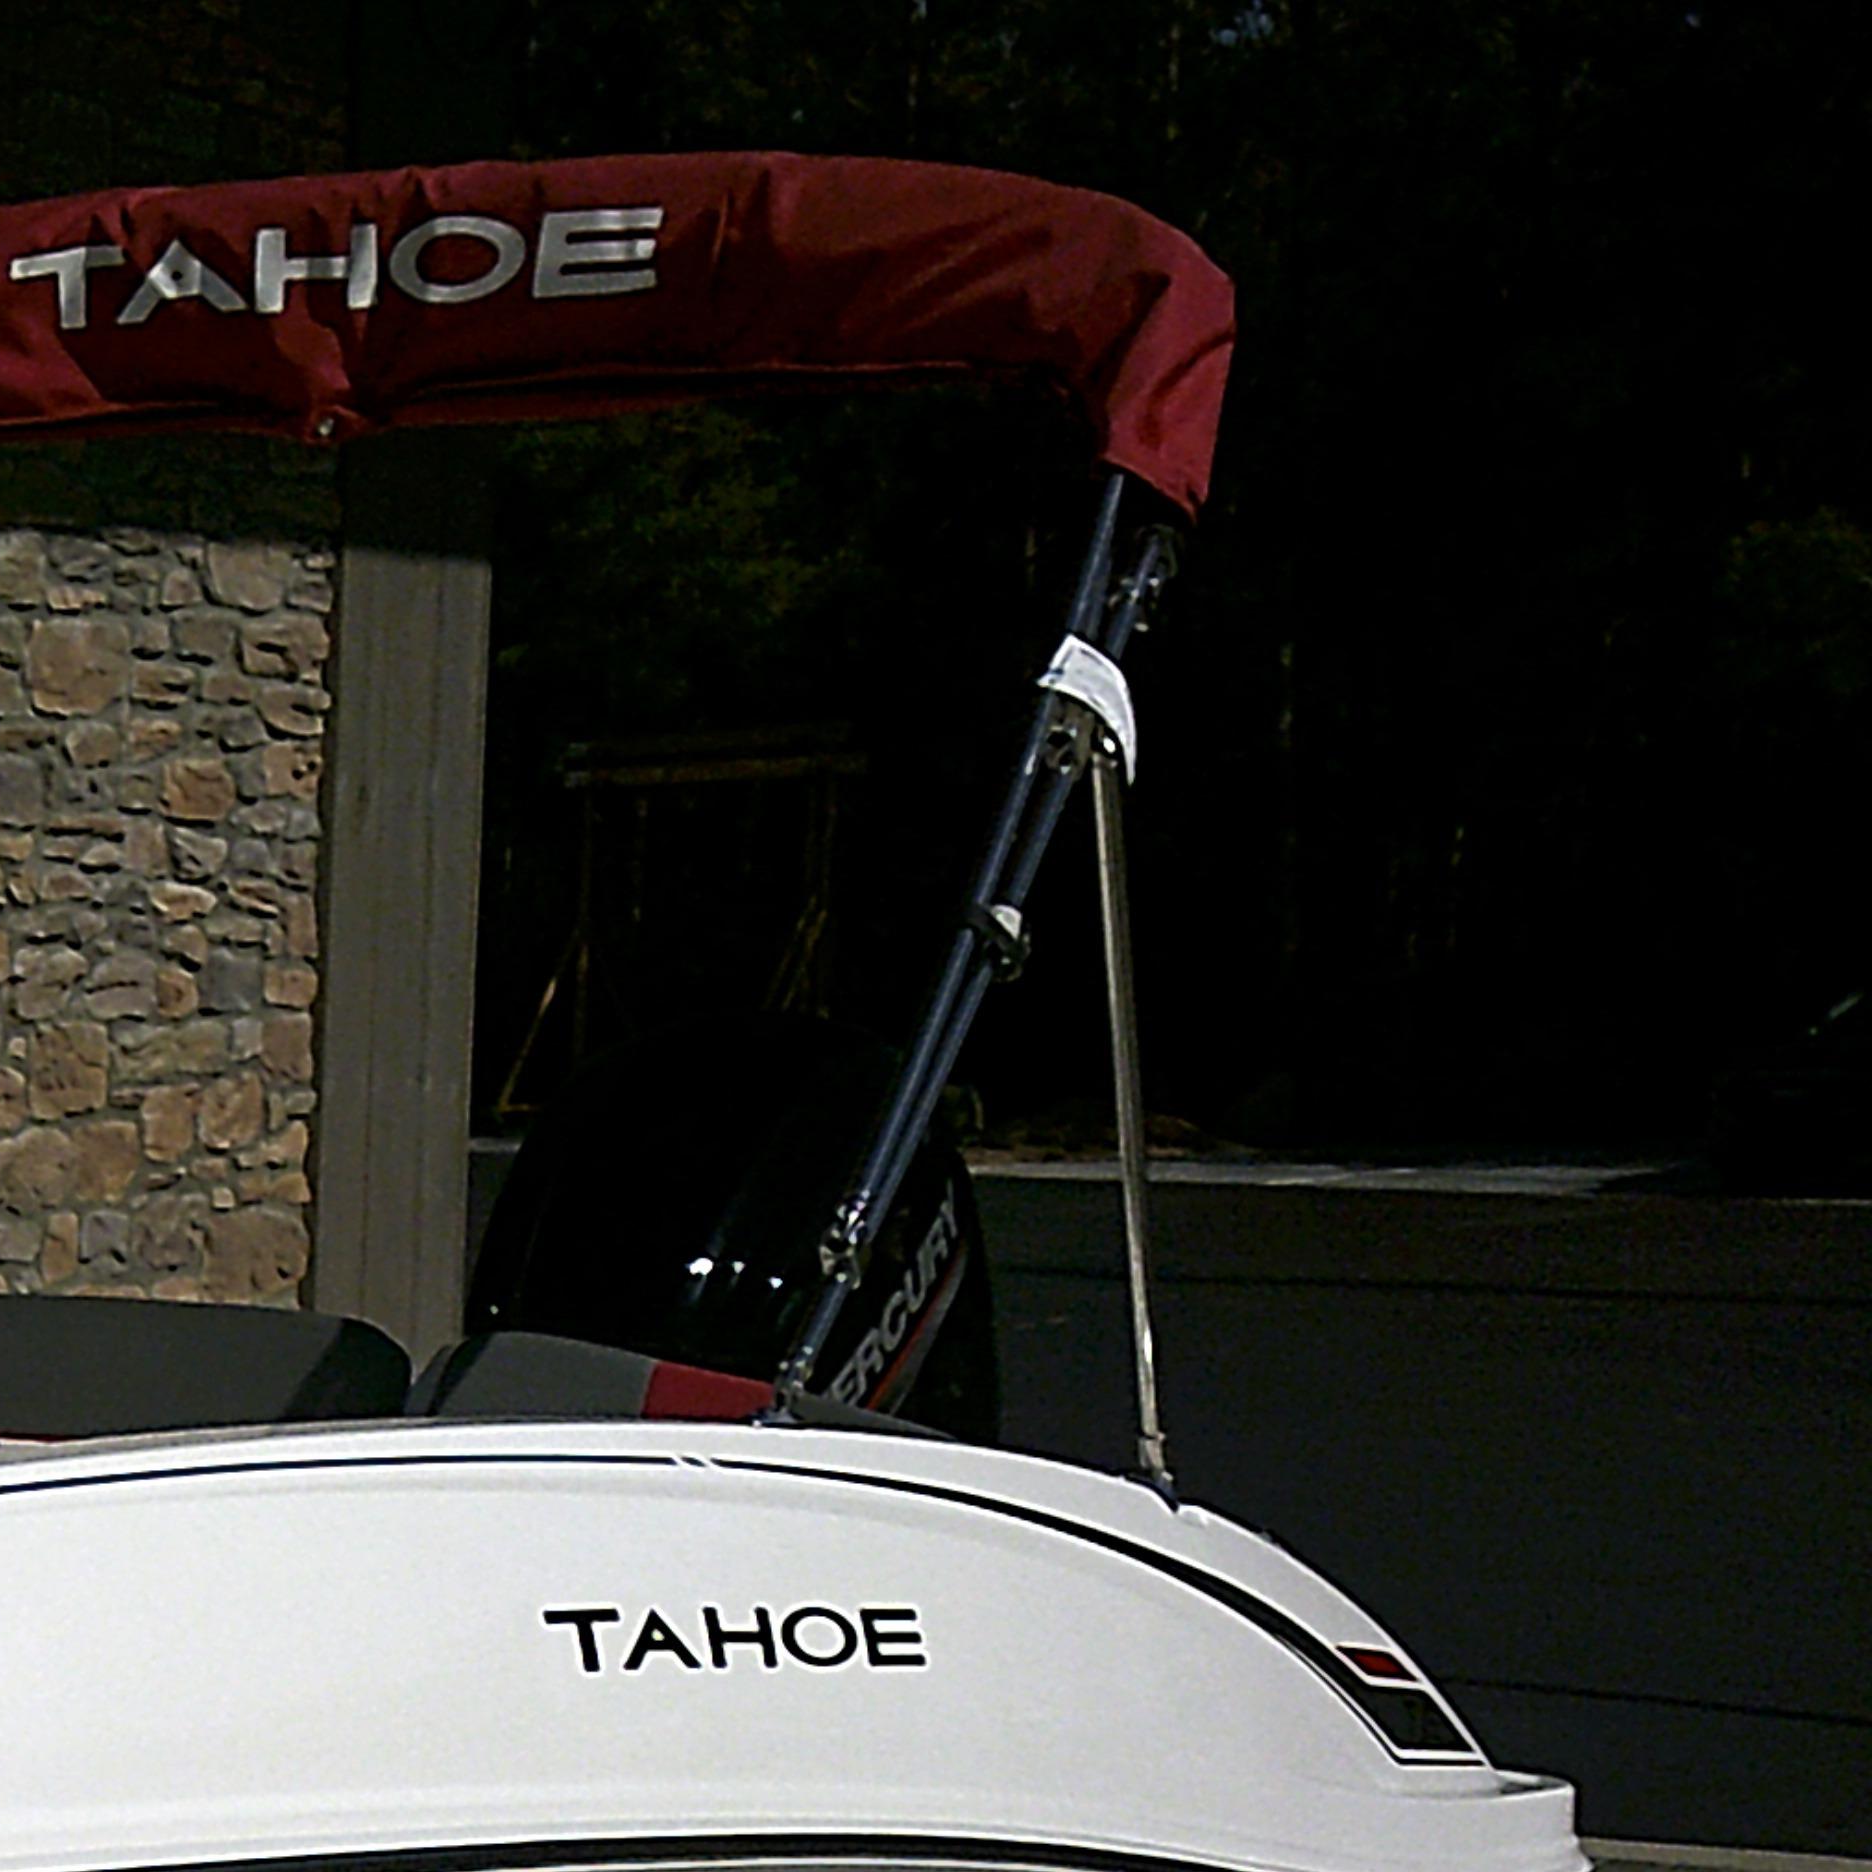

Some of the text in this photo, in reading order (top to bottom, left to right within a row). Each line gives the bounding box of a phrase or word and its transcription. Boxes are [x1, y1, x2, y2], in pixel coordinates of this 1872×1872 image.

[9, 206, 665, 330] TAHOE
[824, 1176, 958, 1408] ERCURY
[542, 1605, 927, 1673] TAHOE
